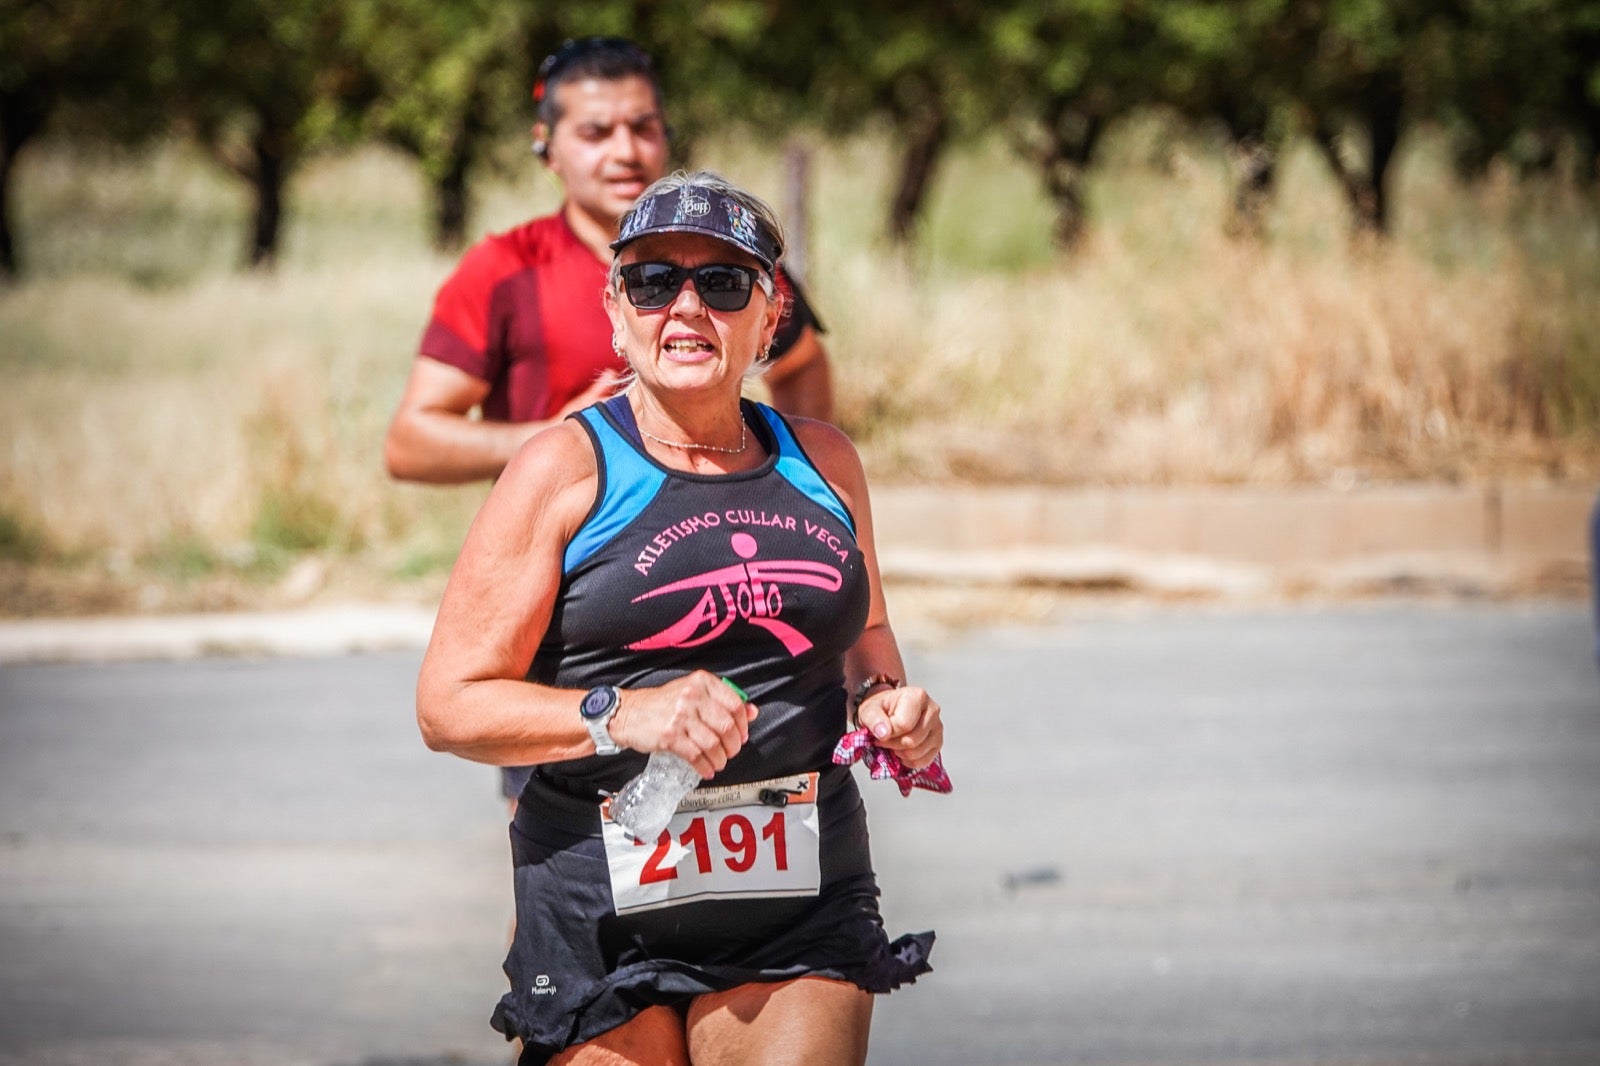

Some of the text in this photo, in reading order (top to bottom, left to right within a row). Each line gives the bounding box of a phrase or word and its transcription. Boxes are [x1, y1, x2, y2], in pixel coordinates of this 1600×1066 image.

[684, 199, 710, 215] Buff
[634, 509, 850, 577] ATLETISMO CULLAR VEGA
[634, 811, 789, 886] 2191
